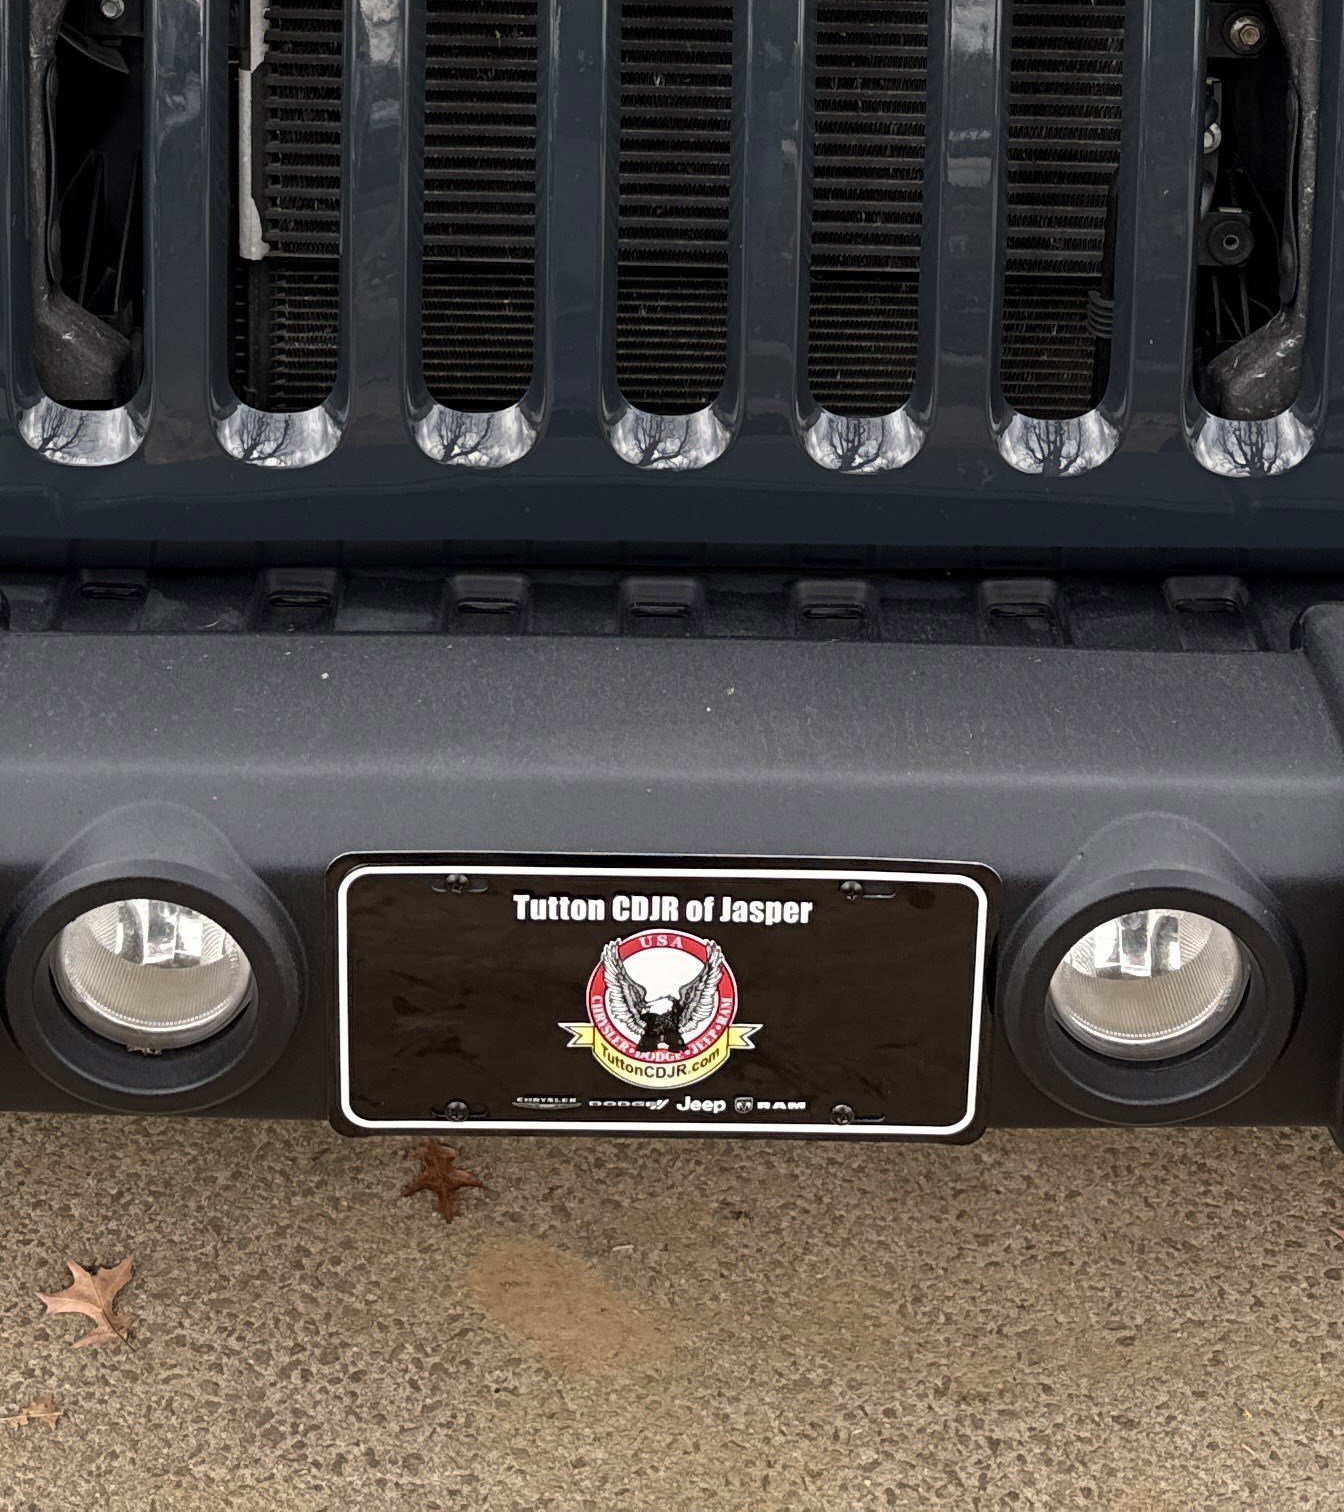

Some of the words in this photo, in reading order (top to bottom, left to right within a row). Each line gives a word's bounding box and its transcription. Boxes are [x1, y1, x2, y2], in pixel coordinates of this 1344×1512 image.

[512, 894, 605, 921] Tutton
[612, 895, 680, 922] CDJR
[685, 896, 715, 922] of
[719, 896, 813, 926] Jasper
[638, 934, 684, 949] USA
[590, 994, 631, 1055] CHRYSLER
[689, 1027, 720, 1056] JEEP
[718, 996, 734, 1028] RAM
[599, 1042, 720, 1079] TuttonCDJR.com
[676, 1095, 727, 1114] Jeep
[756, 1100, 807, 1110] RAM
